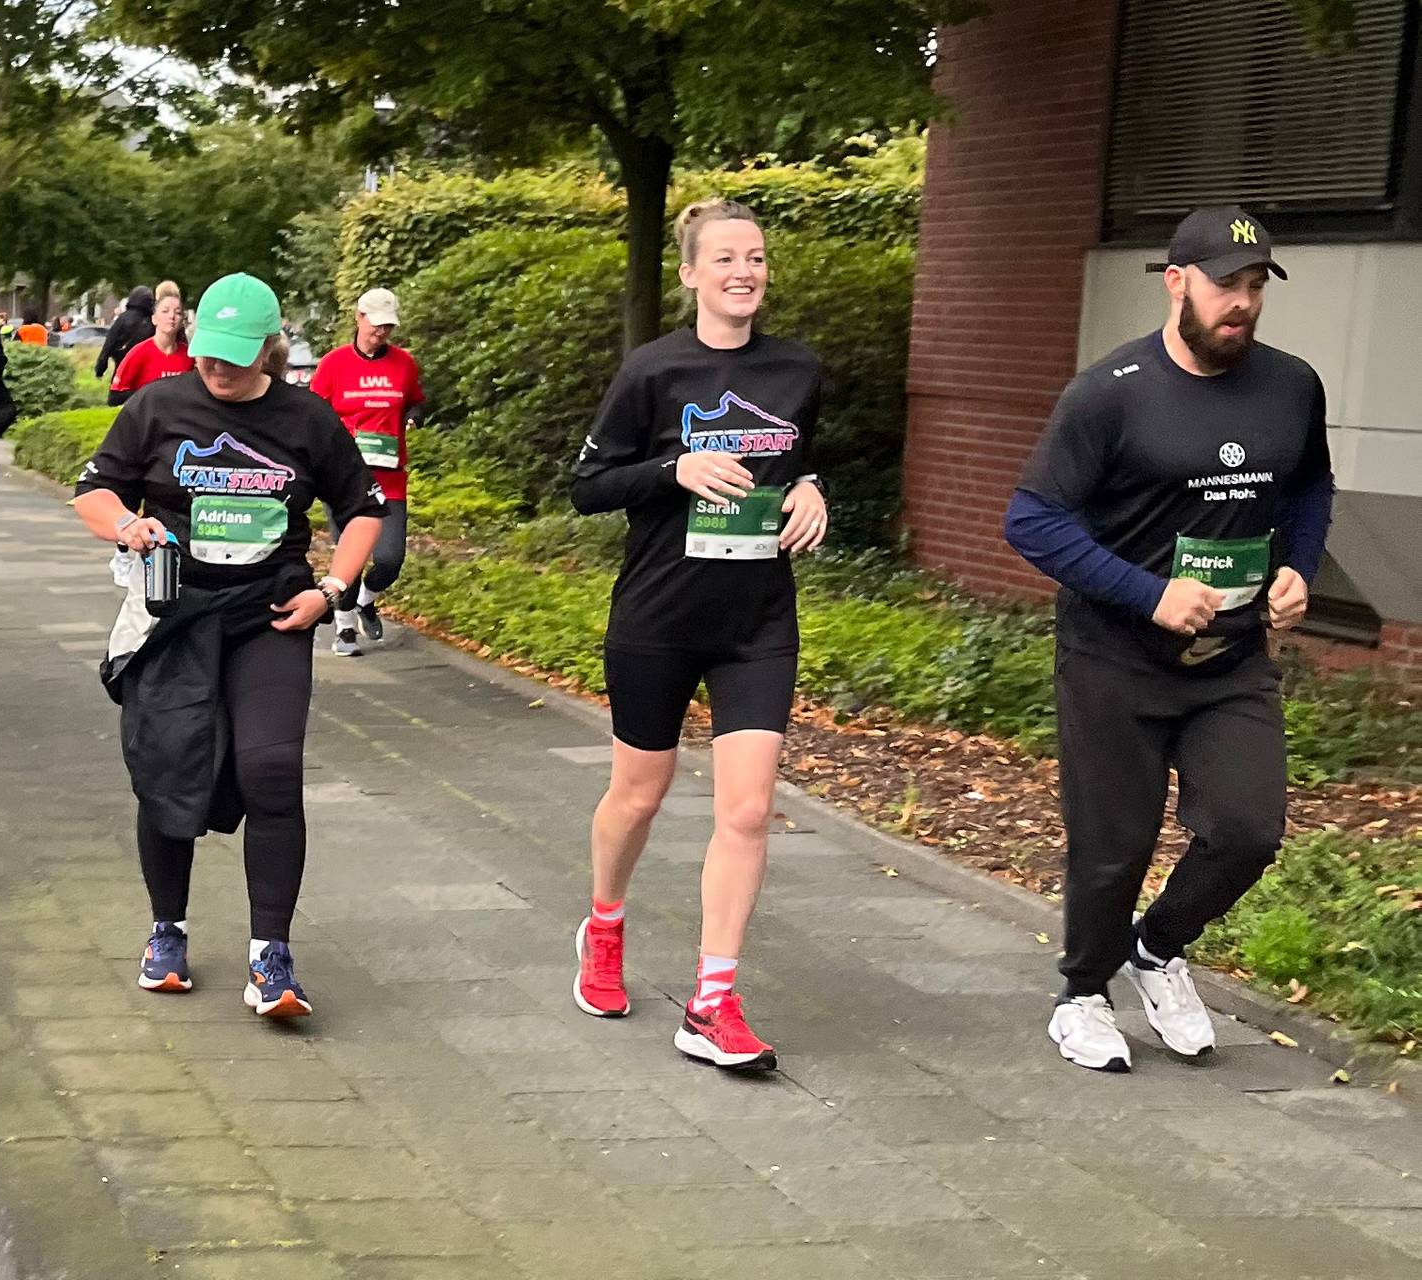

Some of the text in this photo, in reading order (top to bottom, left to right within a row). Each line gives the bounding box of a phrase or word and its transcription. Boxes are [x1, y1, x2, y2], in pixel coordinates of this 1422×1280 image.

[359, 375, 393, 388] LWL
[1188, 472, 1274, 488] MANNESMANN
[1204, 490, 1227, 501] Das
[696, 500, 740, 515] Sarah
[197, 509, 252, 524] Adriana
[1181, 553, 1234, 569] Patrick
